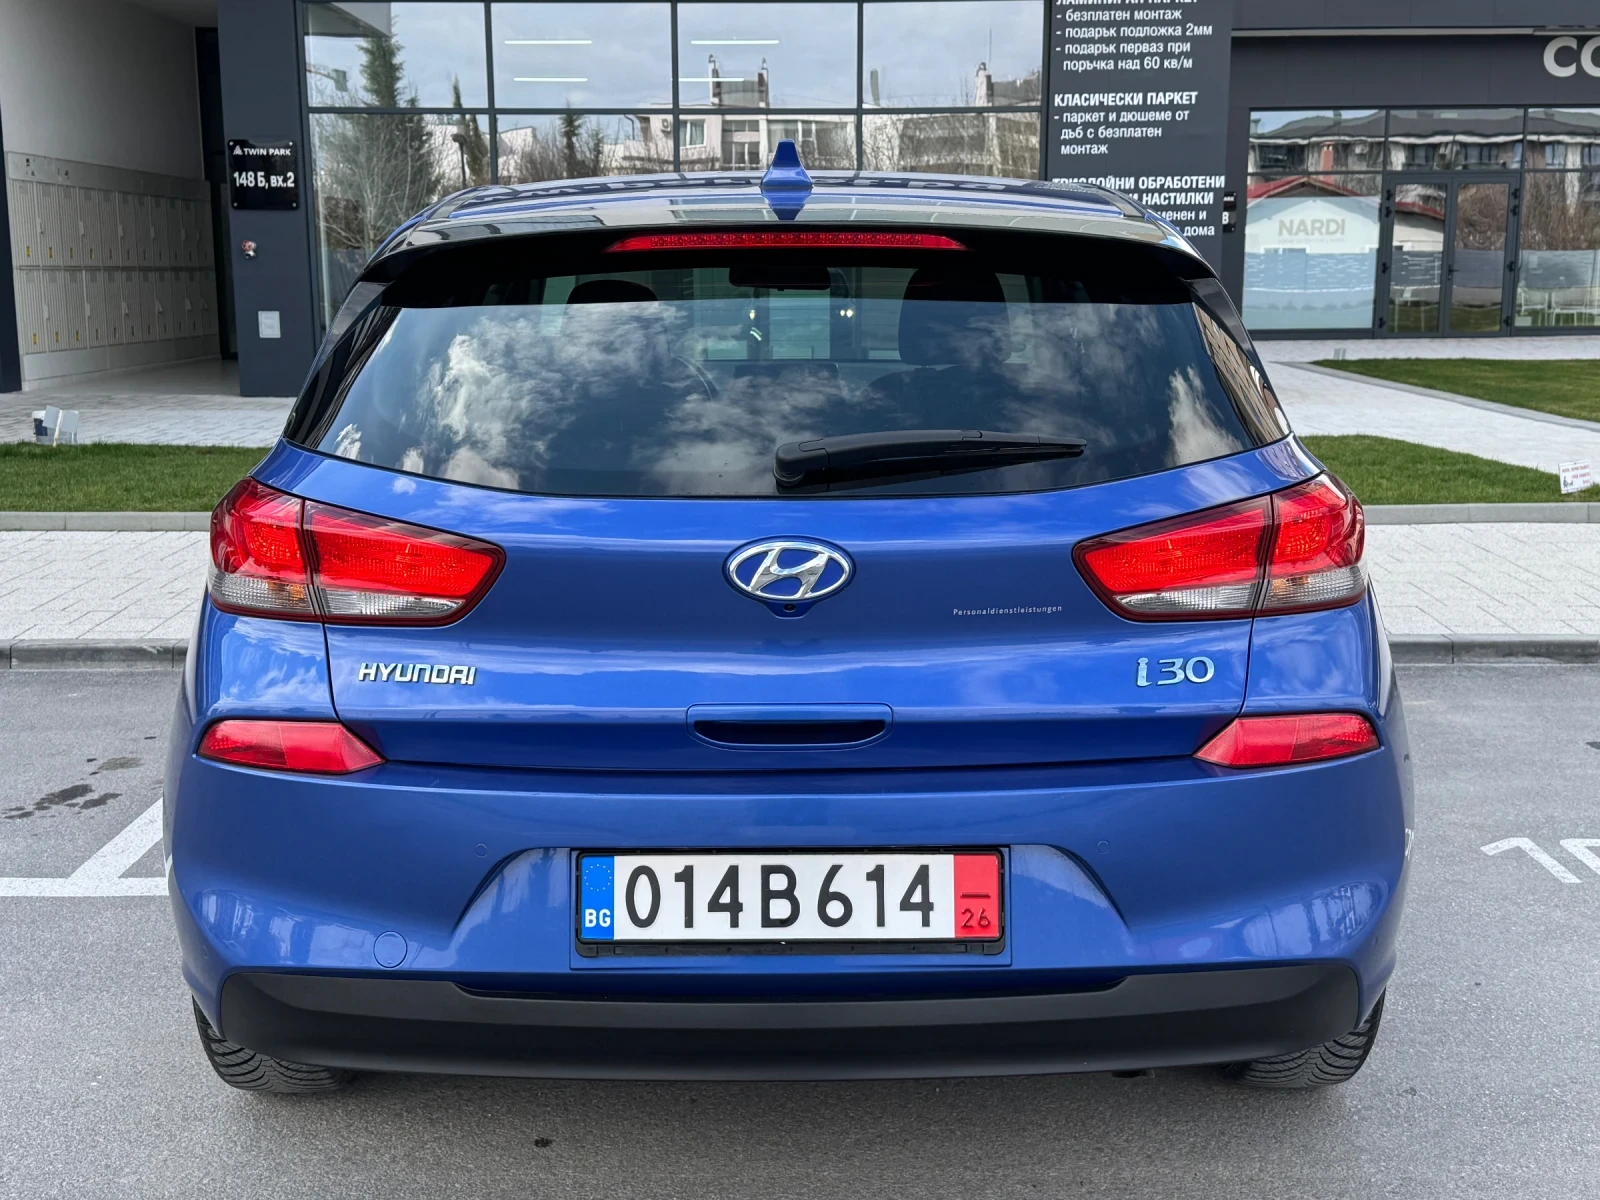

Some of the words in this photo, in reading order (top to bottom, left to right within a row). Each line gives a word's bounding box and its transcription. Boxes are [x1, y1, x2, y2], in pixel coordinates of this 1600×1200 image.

[1065, 8, 1130, 22] безплатен
[1134, 9, 1182, 21] монтаж
[1065, 27, 1117, 40] подарък
[1120, 25, 1182, 38] подложка
[1186, 23, 1213, 36] 2мм
[1064, 43, 1116, 56] подарък
[1119, 41, 1163, 55] перваз
[1167, 41, 1191, 54] при
[1063, 59, 1114, 73] поръчка
[1118, 58, 1140, 70] над
[1143, 56, 1160, 69] 60
[1163, 55, 1193, 70] кв/м
[1054, 93, 1143, 107] КЛАСИЧЕСКИ
[1146, 91, 1198, 105] ПАРКЕТ
[1063, 112, 1105, 125] паркет
[1108, 111, 1117, 122] и
[1119, 110, 1172, 123] дюшеме
[1175, 110, 1190, 121] от
[1060, 126, 1083, 140] дъб
[1086, 128, 1095, 138] с
[1098, 125, 1162, 138] безплатен
[243, 148, 267, 156] TWIN
[269, 148, 291, 156] PARK
[1060, 143, 1109, 155] монтаж
[233, 171, 256, 187] 148
[1138, 175, 1226, 189] ОБРАБОТЕНИ
[1142, 191, 1214, 205] НАСТИЛКИ
[1183, 225, 1215, 237] дома
[1278, 218, 1346, 236] NARDI
[953, 605, 1063, 616] Personaldienstleistungen
[358, 662, 477, 685] HYUNDAI
[584, 909, 611, 929] BG
[961, 907, 991, 928] 26
